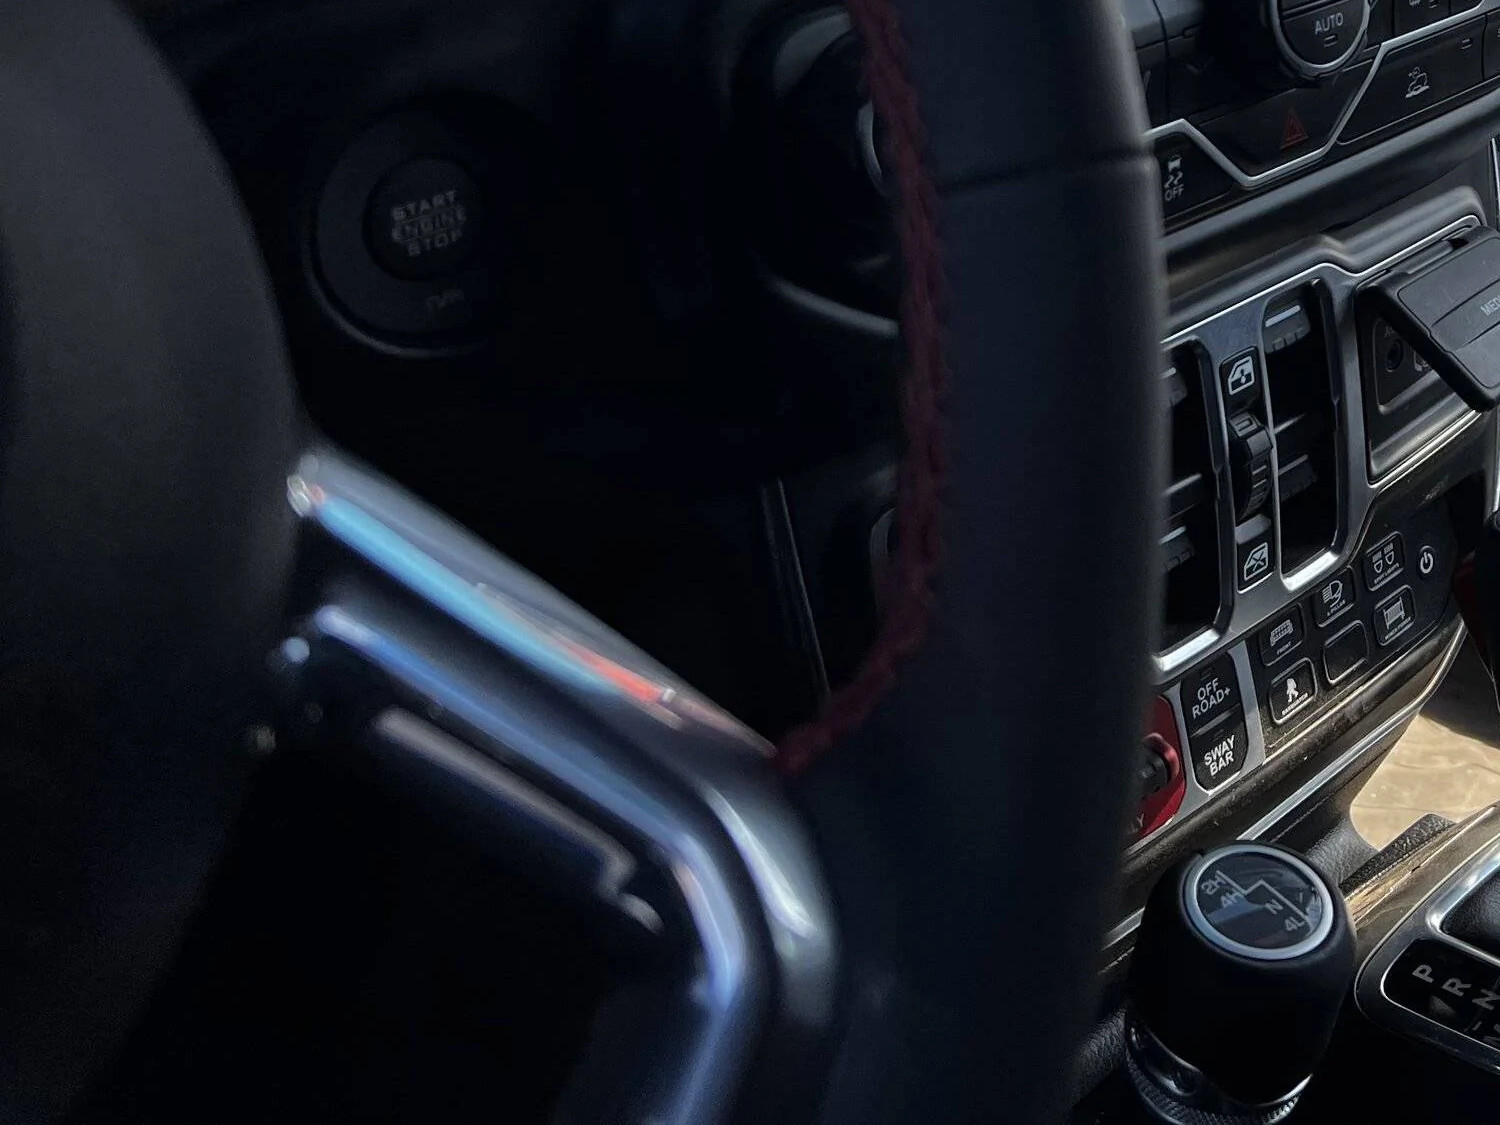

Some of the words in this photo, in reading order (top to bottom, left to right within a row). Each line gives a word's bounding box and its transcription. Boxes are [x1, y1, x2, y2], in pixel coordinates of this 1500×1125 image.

[1315, 12, 1344, 35] AUTO
[1164, 182, 1185, 202] OFF
[1197, 678, 1218, 700] OFF
[1192, 687, 1231, 719] ROAD+
[1204, 734, 1235, 765] SWAY
[1209, 750, 1235, 776] BAR
[1201, 874, 1226, 895] 2H
[1220, 887, 1243, 908] 4H
[1265, 899, 1284, 915] N
[1285, 916, 1306, 932] 4L
[1411, 963, 1435, 984] P
[1441, 976, 1472, 997] R
